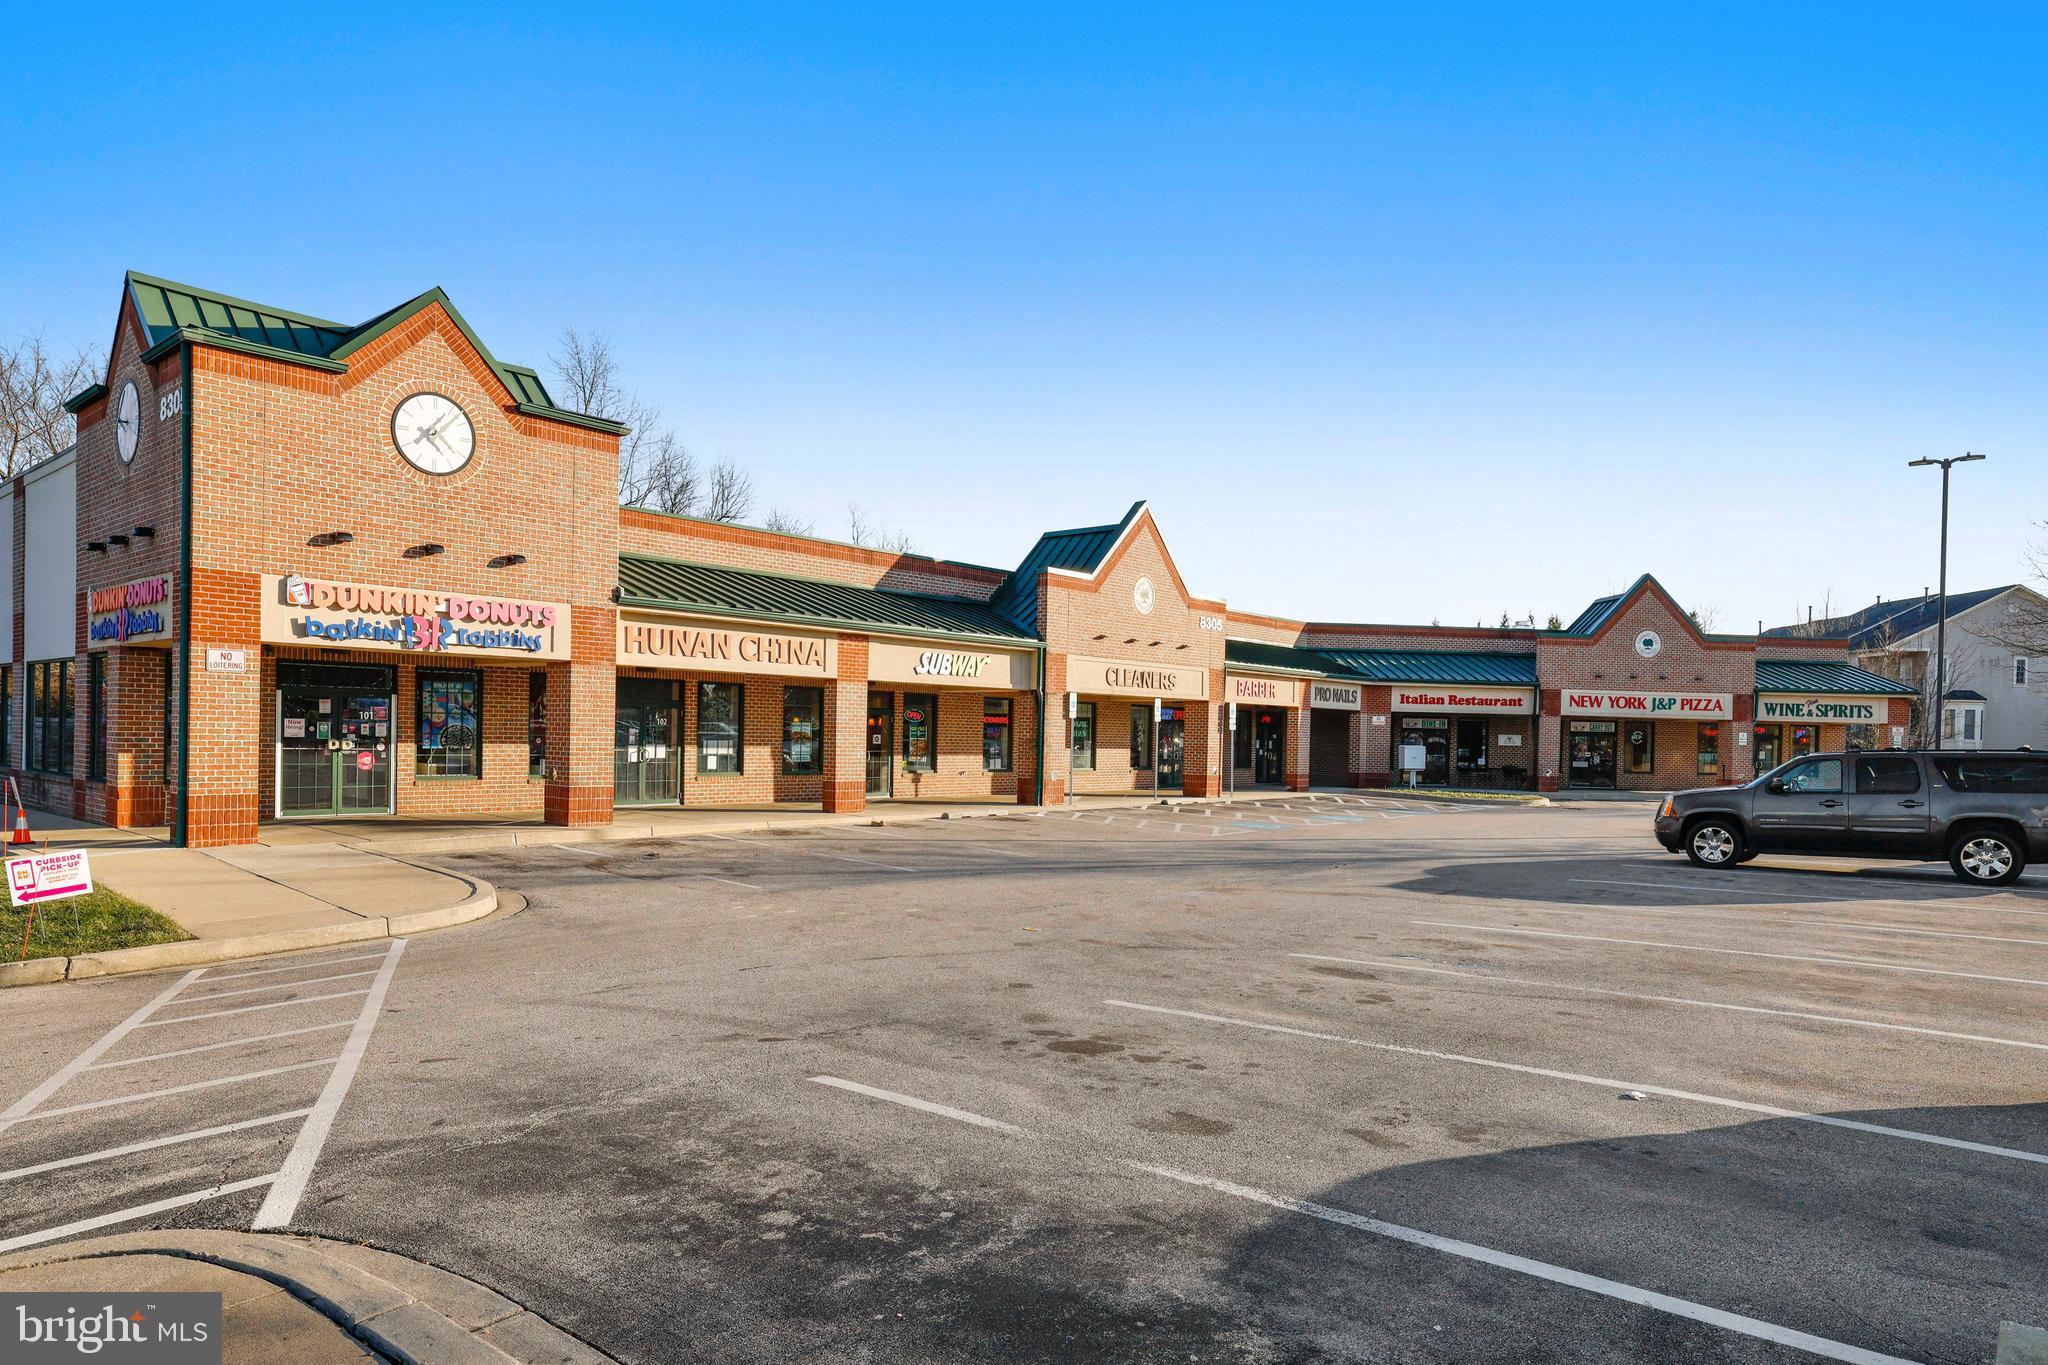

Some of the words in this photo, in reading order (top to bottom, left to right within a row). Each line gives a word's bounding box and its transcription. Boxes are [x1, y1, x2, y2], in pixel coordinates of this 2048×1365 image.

[160, 387, 183, 421] 830
[127, 577, 165, 608] DONUTS
[448, 596, 557, 627] DONUTS
[1199, 616, 1223, 631] 8305
[305, 615, 399, 642] baskin
[457, 628, 543, 652] robbins
[624, 625, 731, 660] HUNAN
[739, 635, 823, 667] CHINA
[220, 652, 233, 661] NO
[913, 651, 992, 677] SUBWAY
[209, 661, 243, 670] LOITERING
[1105, 667, 1177, 691] CLEANERS
[1237, 679, 1277, 699] BARBER
[1314, 686, 1332, 702] PRO
[1332, 687, 1358, 704] NAILS
[1399, 693, 1446, 706] Italian
[1447, 694, 1524, 707] Restaurant
[1569, 694, 1604, 708] NEW
[1607, 695, 1648, 710] YORK
[1651, 697, 1677, 712] J&P
[1680, 698, 1724, 712] PIZZA
[359, 711, 374, 719] 101
[906, 711, 922, 720] OPEN
[1764, 702, 1805, 717] WINE
[1806, 708, 1814, 717] &
[1815, 704, 1874, 719] SPIRITS
[656, 718, 668, 726] 102
[1421, 720, 1446, 728] DINE-IN
[36, 853, 82, 866] CURBSIDE
[40, 861, 80, 872] PICK-UP
